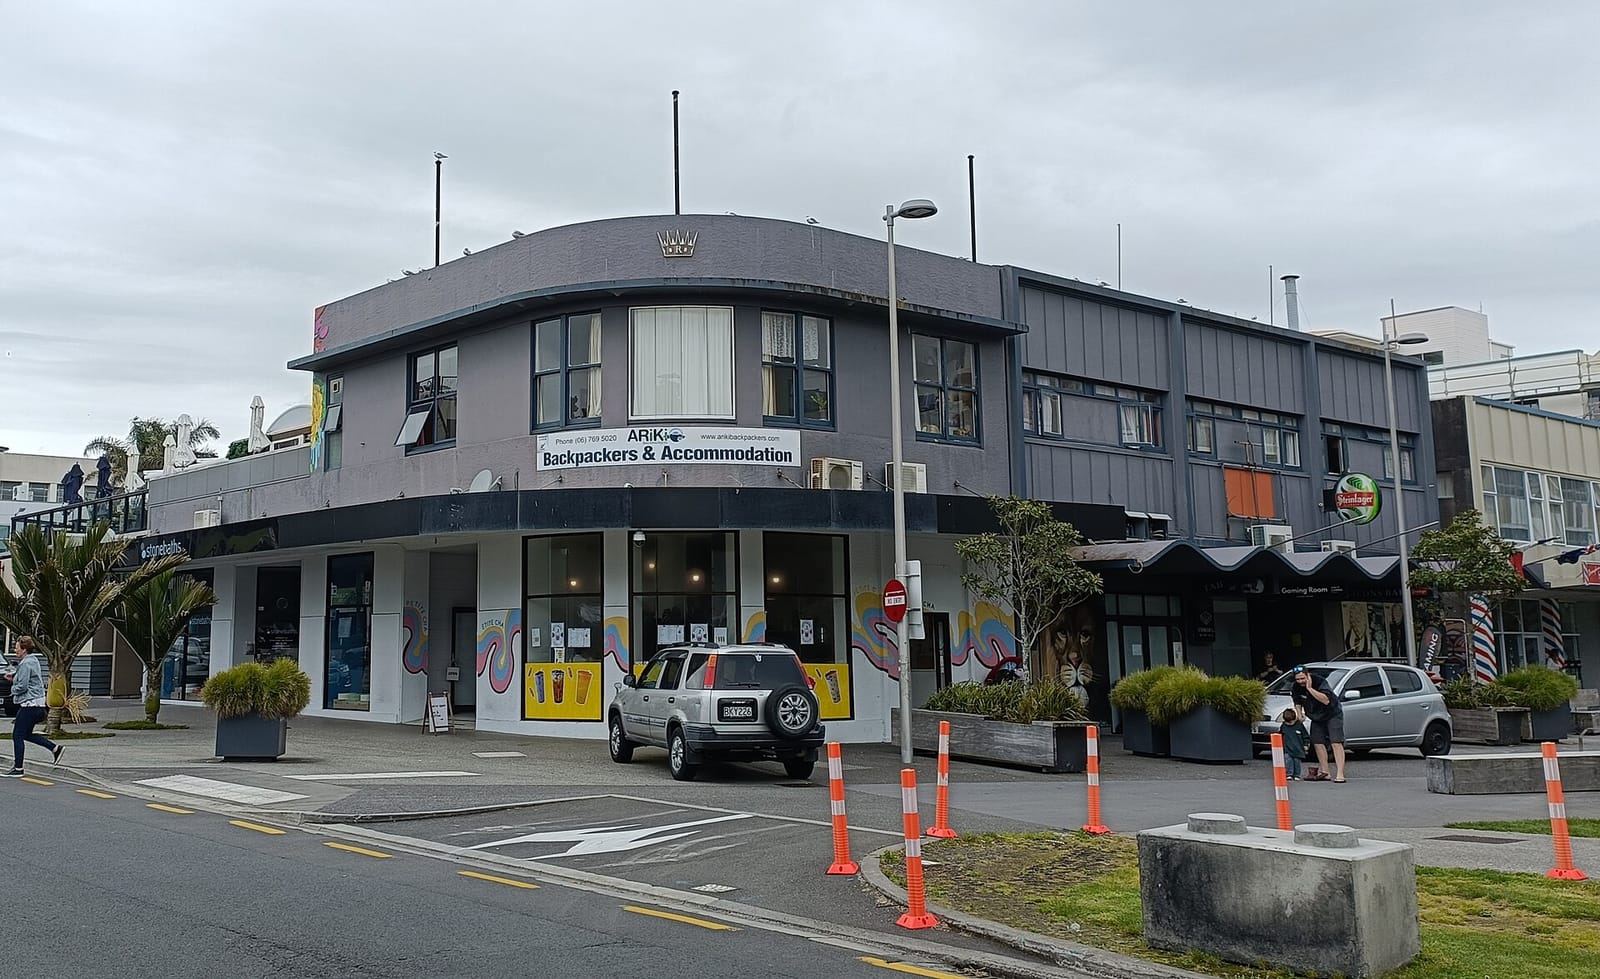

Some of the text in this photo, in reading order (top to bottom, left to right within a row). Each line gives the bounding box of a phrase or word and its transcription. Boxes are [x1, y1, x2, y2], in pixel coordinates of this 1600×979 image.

[575, 436, 587, 444] (06)
[601, 434, 617, 442] 5020
[700, 433, 780, 442] www.arikibackpackers.com
[543, 445, 793, 467] Backpackers & Accommodation
[1337, 493, 1373, 506] Steinlager
[146, 538, 182, 558] stonebaths
[1281, 587, 1308, 595] Gaming
[1423, 633, 1439, 672] AMING
